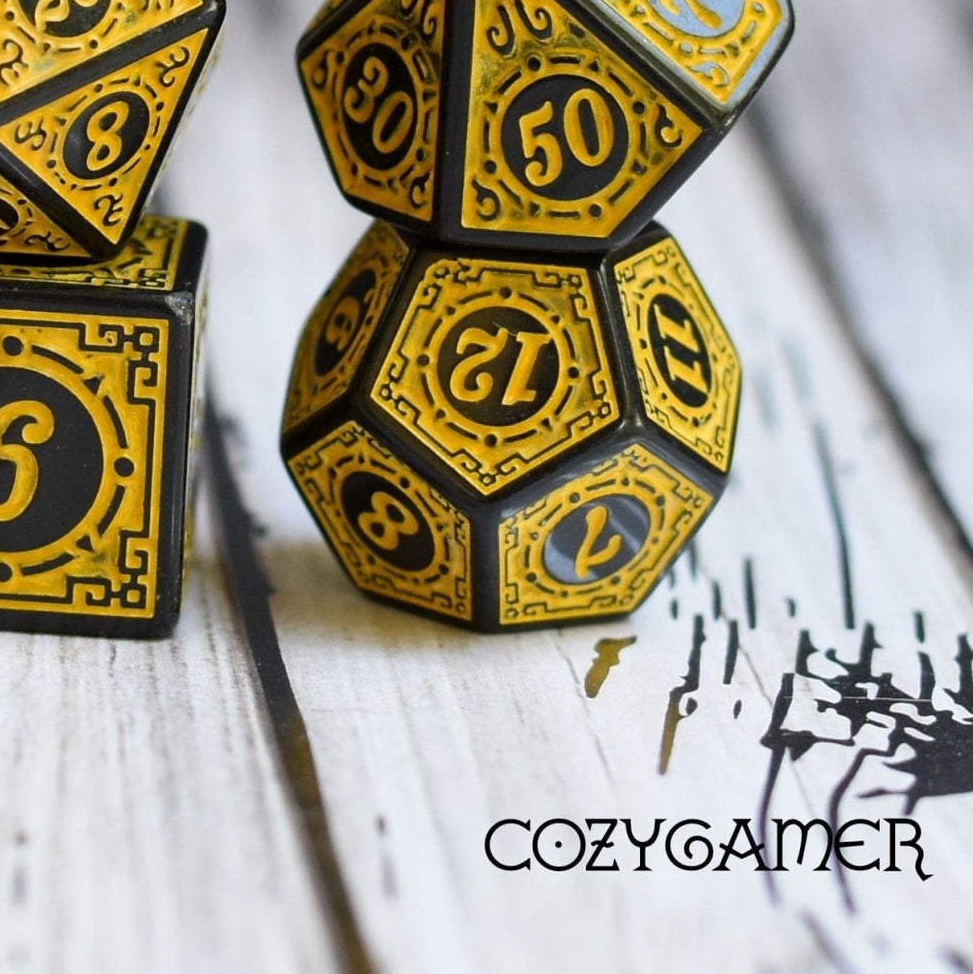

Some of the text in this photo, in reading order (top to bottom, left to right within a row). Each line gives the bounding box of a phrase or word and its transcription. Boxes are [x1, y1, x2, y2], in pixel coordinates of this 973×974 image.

[87, 100, 130, 172] 8
[342, 55, 412, 155] 30
[519, 88, 615, 188] 50
[448, 325, 555, 407] 12
[653, 308, 710, 393] 11
[357, 491, 420, 551] 8
